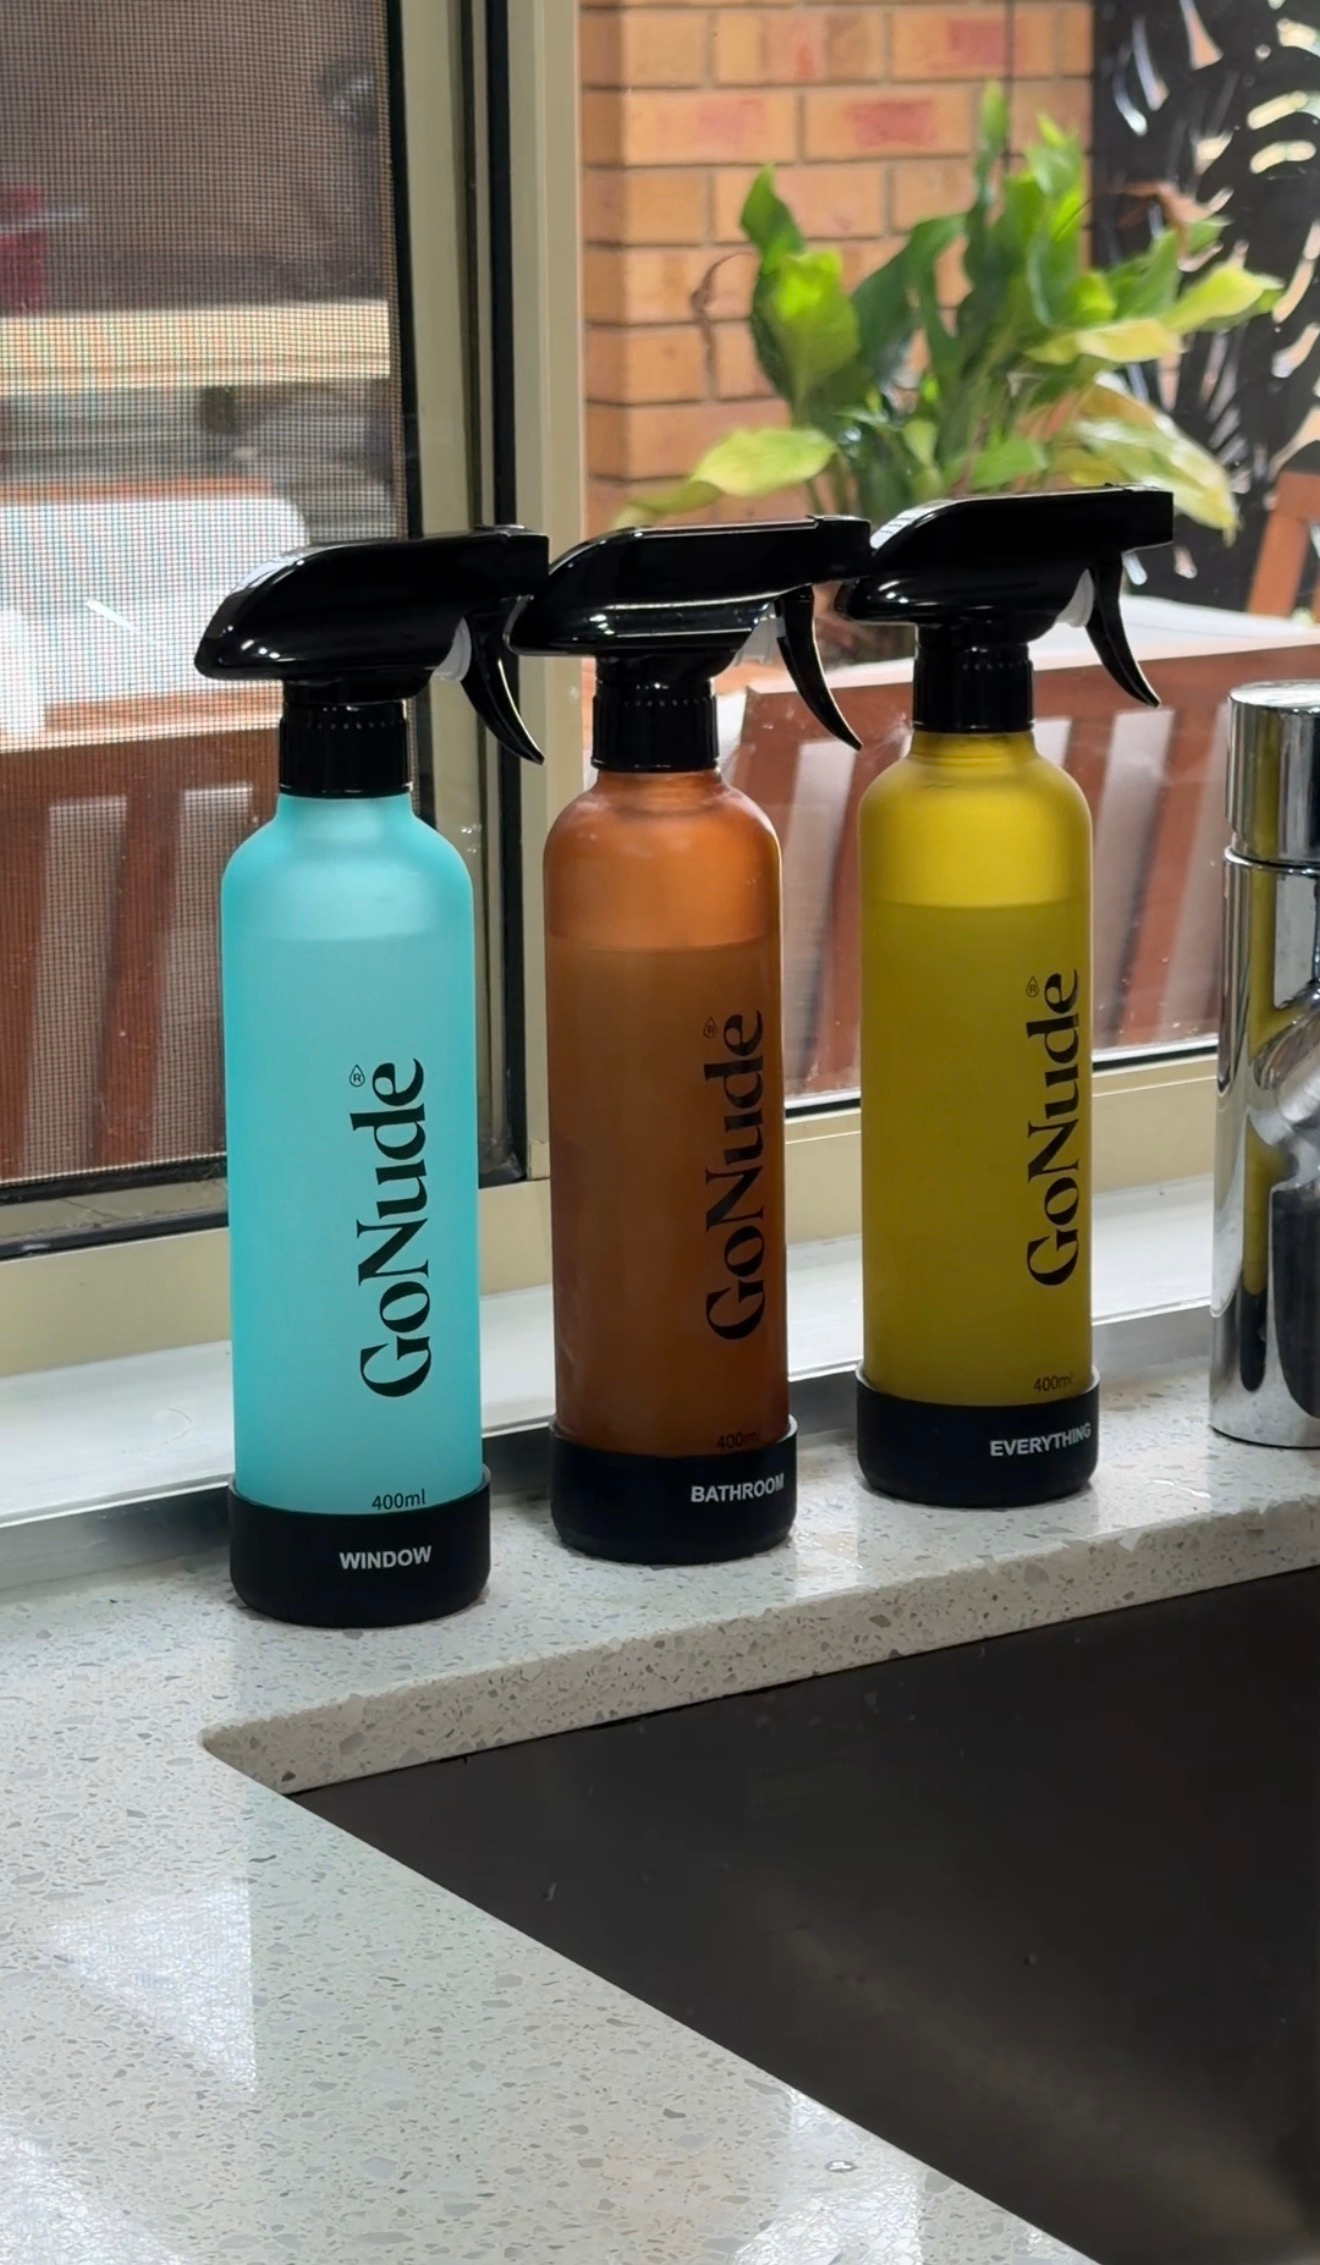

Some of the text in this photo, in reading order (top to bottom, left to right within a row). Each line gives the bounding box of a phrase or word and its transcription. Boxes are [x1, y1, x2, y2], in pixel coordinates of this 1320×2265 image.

[1026, 969, 1079, 1285] GoNude
[704, 1010, 764, 1340] GoNude
[350, 1057, 432, 1398] GoNude
[990, 1422, 1091, 1456] EVERYTHING
[371, 1488, 426, 1510] 400ml
[691, 1472, 784, 1502] BATHROOM
[339, 1545, 432, 1570] WINDOW
